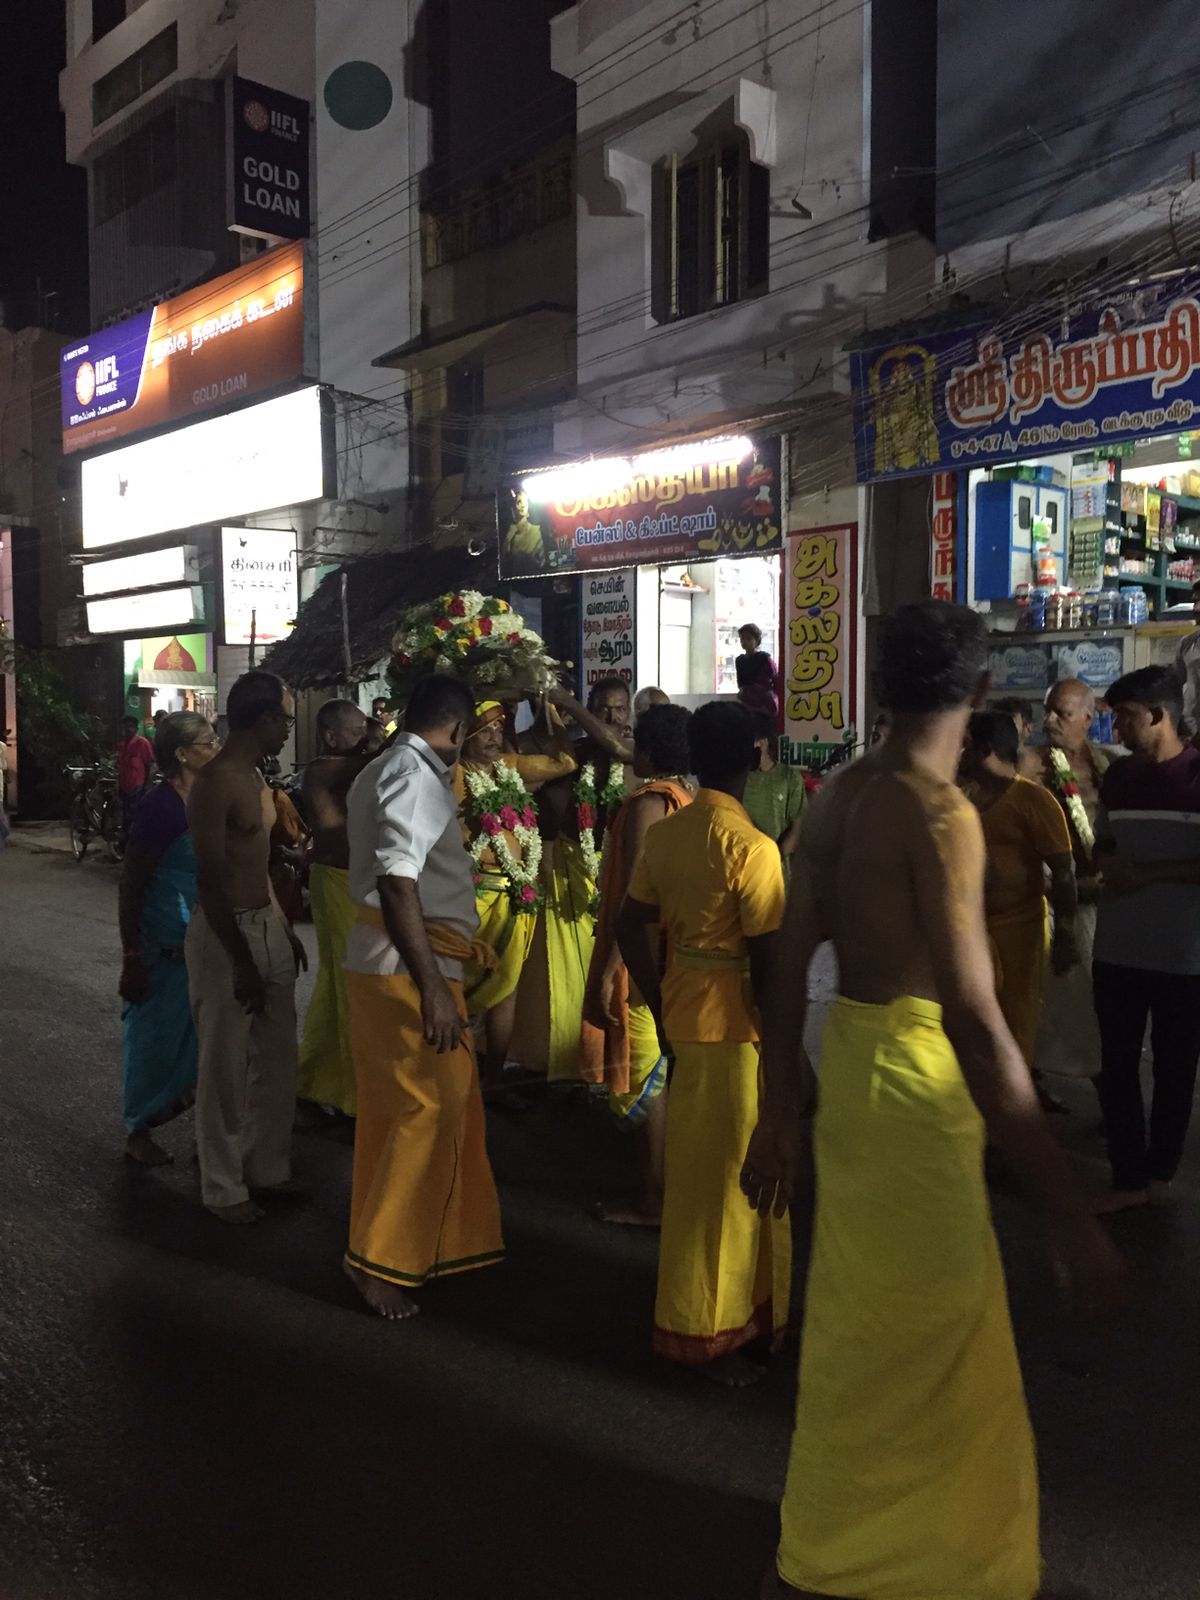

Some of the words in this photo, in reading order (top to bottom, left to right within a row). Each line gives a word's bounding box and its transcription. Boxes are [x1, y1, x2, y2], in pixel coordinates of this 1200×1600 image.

[270, 110, 300, 135] IIFL
[243, 156, 300, 190] GOLD
[243, 183, 300, 218] LOAN
[95, 355, 119, 385] IIFL
[192, 383, 218, 406] GOLD
[220, 372, 247, 397] LOAN
[575, 519, 623, 547] பேன்ஸி
[625, 520, 637, 542] &
[680, 505, 716, 537] ஷாப்
[590, 575, 625, 596] செயின்
[586, 595, 629, 616] வளையல்
[598, 633, 632, 666] ஆரம்
